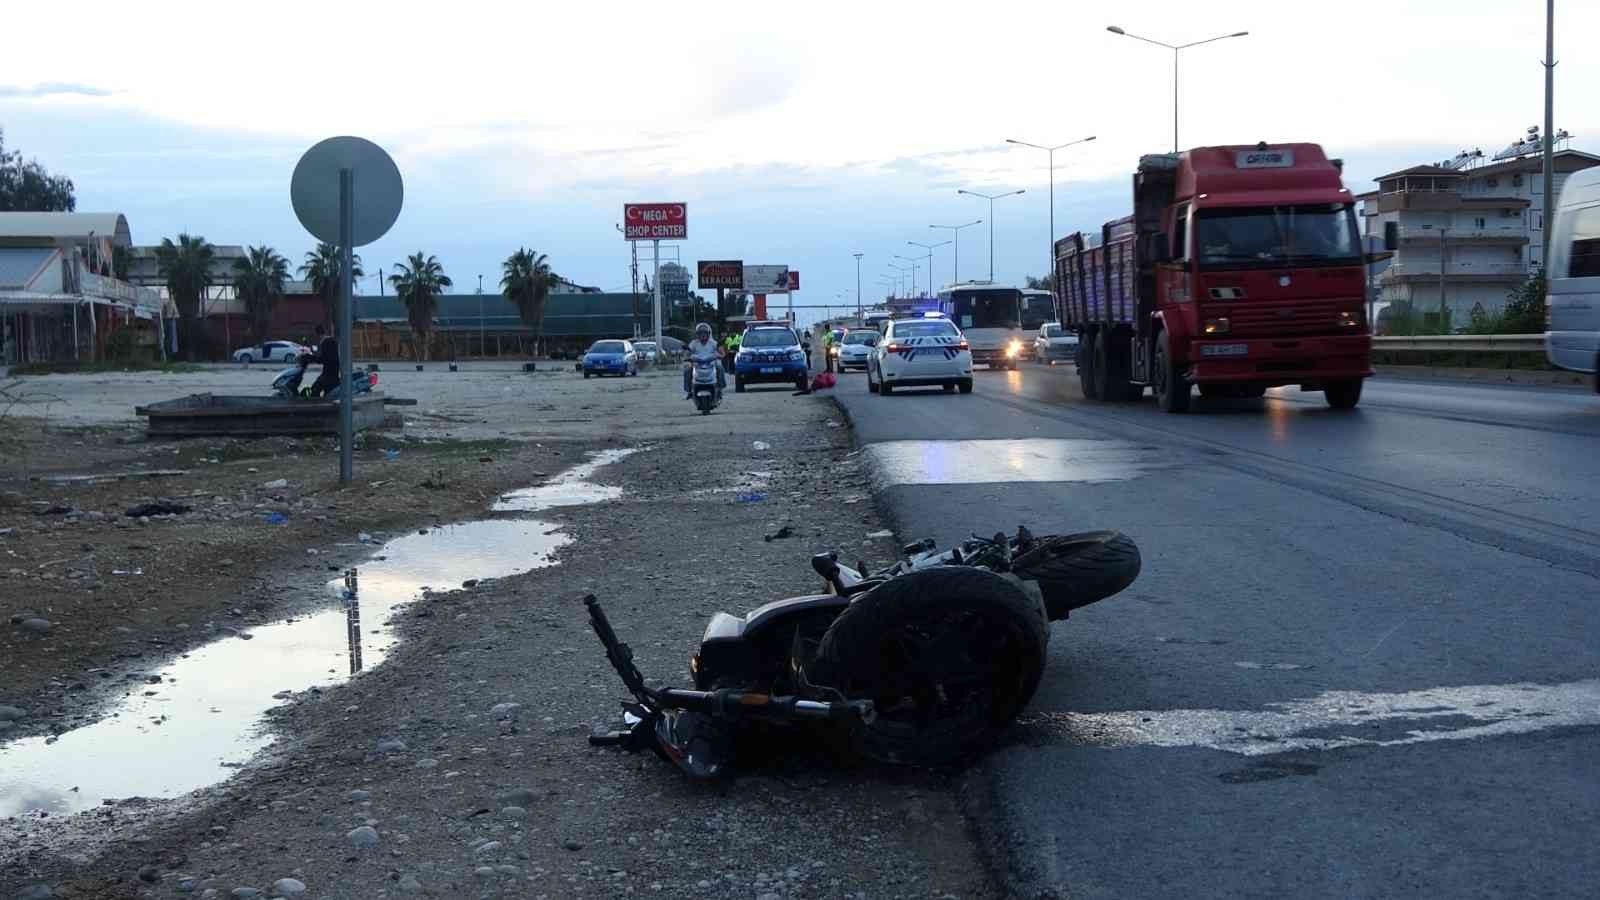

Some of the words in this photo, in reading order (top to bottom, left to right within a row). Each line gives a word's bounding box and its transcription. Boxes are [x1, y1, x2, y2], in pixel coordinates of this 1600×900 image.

[643, 210, 668, 221] MEGA
[626, 225, 649, 236] SHOP
[652, 225, 685, 236] CENTER
